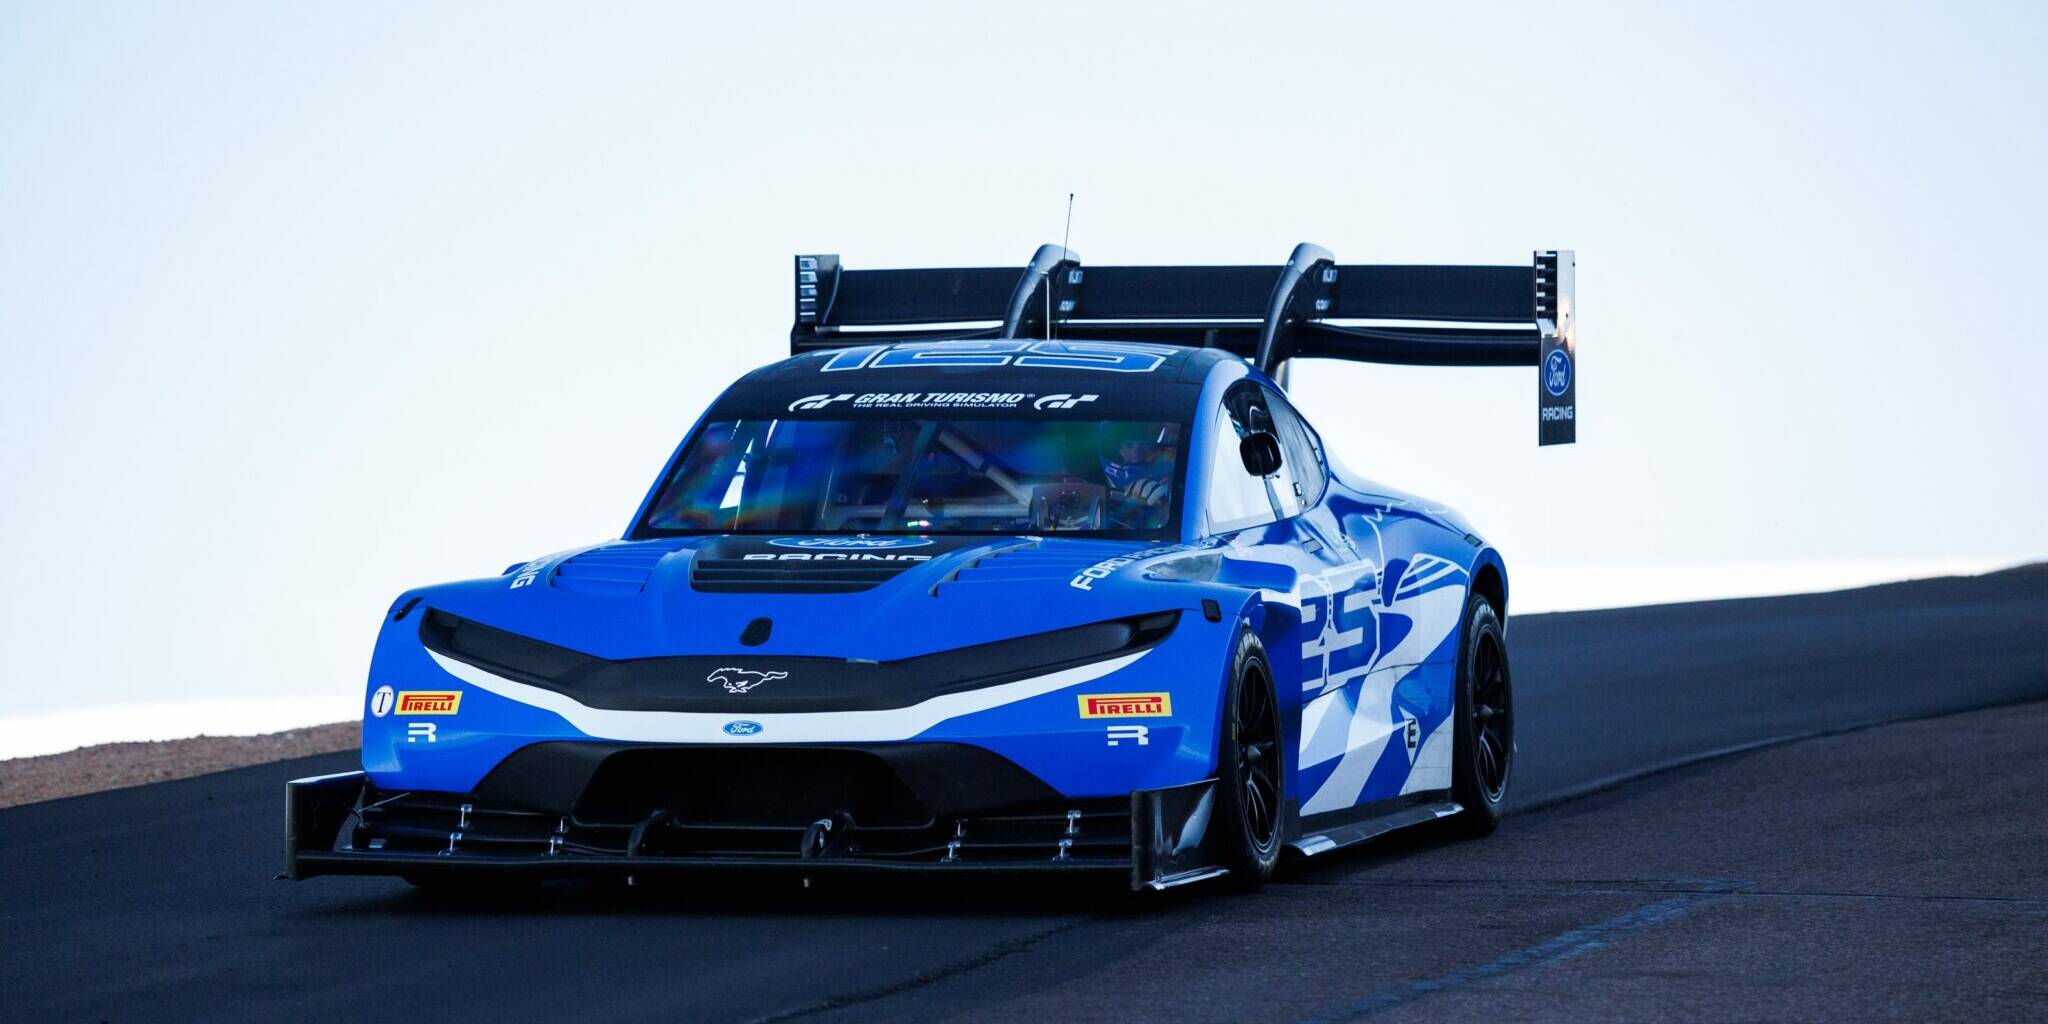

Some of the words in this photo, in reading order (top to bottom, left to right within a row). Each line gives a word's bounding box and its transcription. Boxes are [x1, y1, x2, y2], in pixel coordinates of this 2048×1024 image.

[814, 340, 1180, 373] 125
[1549, 355, 1568, 387] Ford
[854, 393, 922, 404] GRAN
[1542, 406, 1574, 422] RACING
[1070, 557, 1136, 591] FORD
[376, 691, 392, 713] T
[401, 694, 455, 711] PIRELLI
[1087, 696, 1162, 715] PIRELLI
